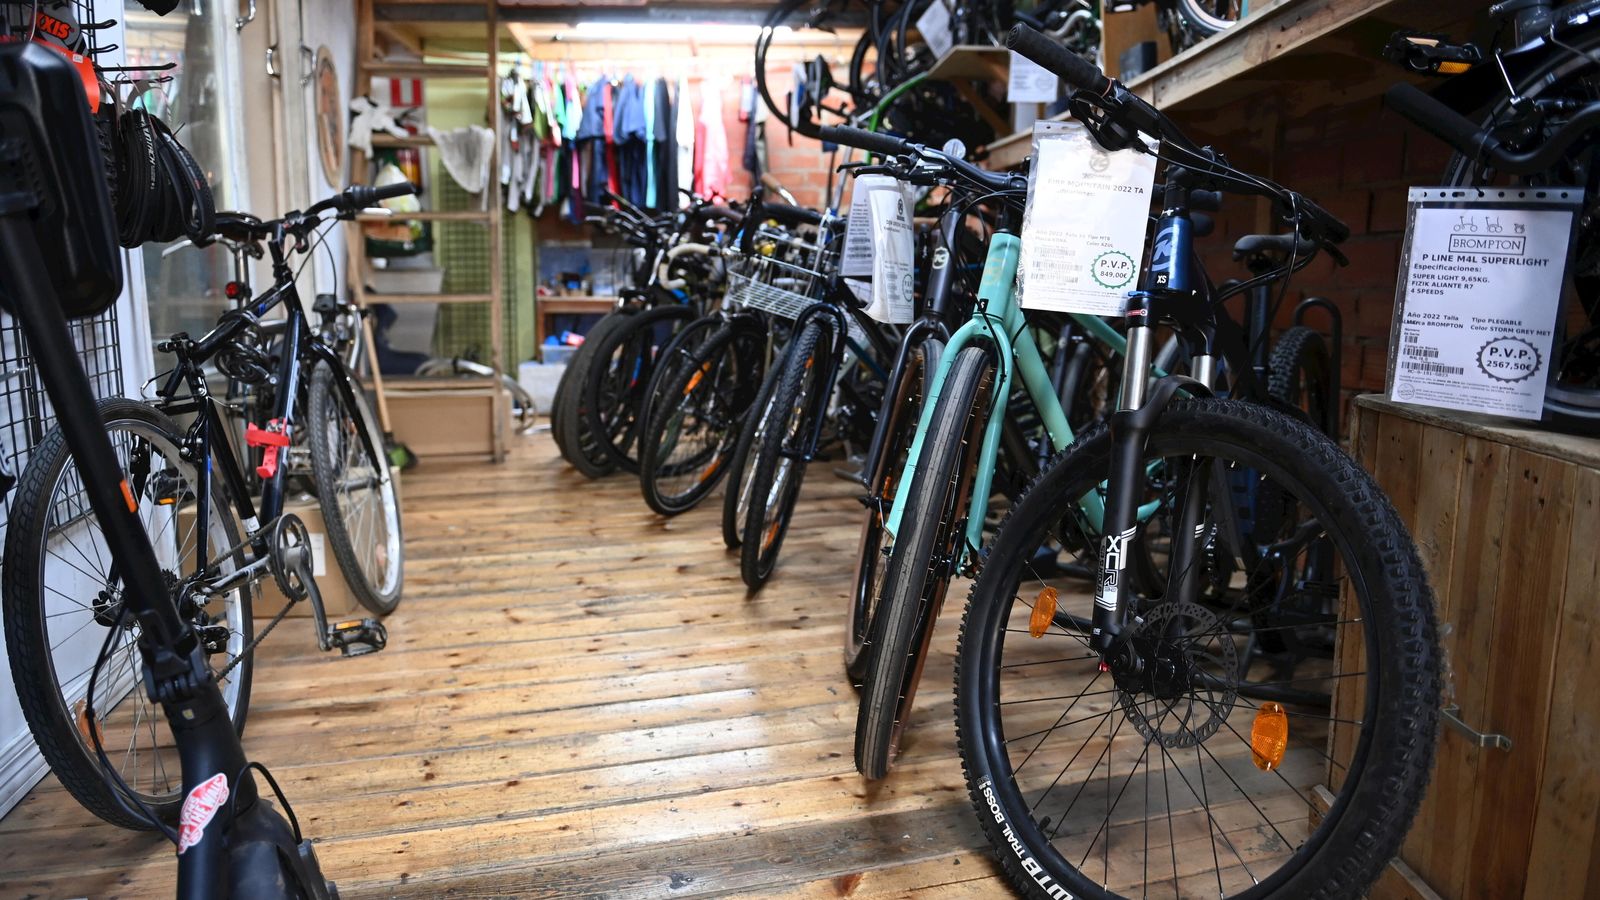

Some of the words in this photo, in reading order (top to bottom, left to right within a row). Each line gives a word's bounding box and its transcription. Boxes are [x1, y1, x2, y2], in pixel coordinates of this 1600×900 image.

[1113, 185, 1132, 193] 2022
[1452, 238, 1522, 251] BROMPTON
[1100, 259, 1130, 270] P.V.P.
[1422, 253, 1429, 261] P
[1431, 254, 1454, 263] LINE
[1456, 255, 1478, 264] M4L
[1480, 256, 1550, 267] SUPERLIGHT
[1413, 263, 1482, 273] Especificaciones:
[1099, 270, 1128, 278] 849,00€
[1156, 274, 1167, 284] XS
[1412, 273, 1436, 281] SUPER
[1431, 281, 1461, 289] ALIANTE
[1407, 311, 1421, 319] Año
[1487, 318, 1523, 326] PLEGABLE
[1426, 321, 1464, 329] BROMPTON
[1489, 346, 1532, 360] P.V.P.
[1486, 360, 1533, 371] 2567,50€
[1103, 535, 1121, 588] XCR
[983, 787, 1005, 824] BOSS
[1002, 822, 1026, 859] TRAIL
